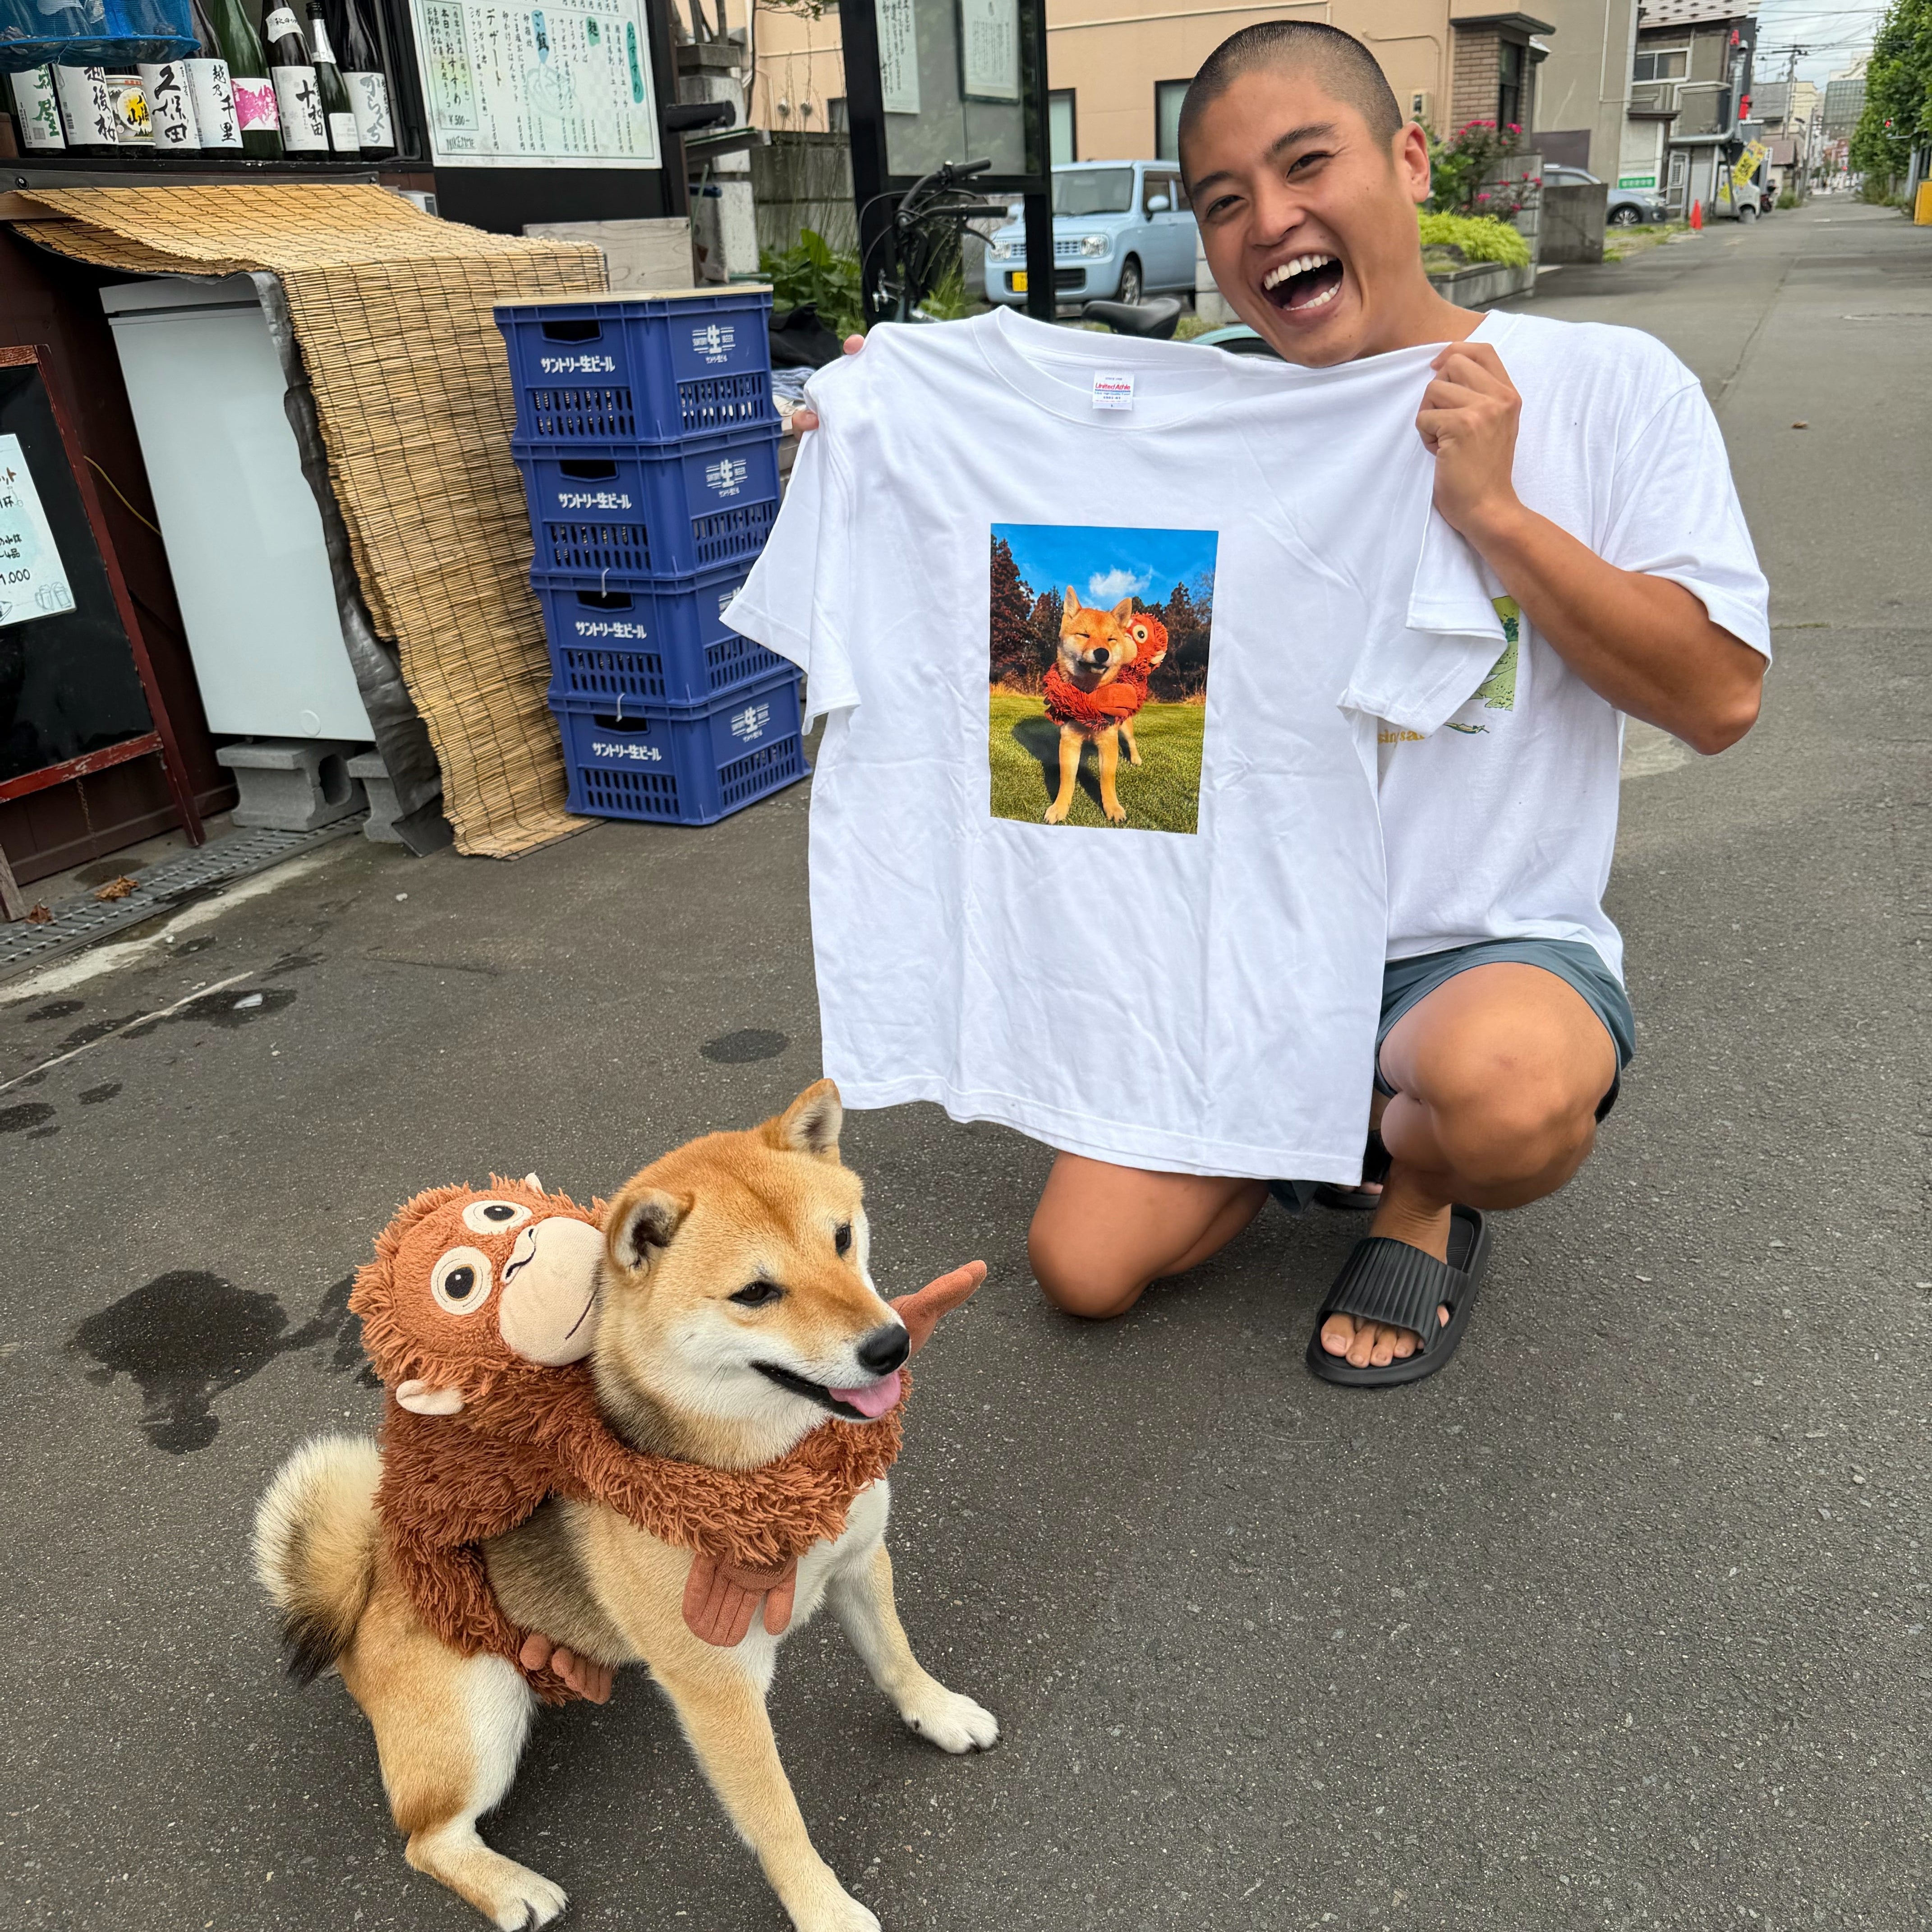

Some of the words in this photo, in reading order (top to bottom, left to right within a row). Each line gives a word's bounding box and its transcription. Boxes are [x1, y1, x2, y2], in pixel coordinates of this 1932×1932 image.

[476, 9, 487, 64] ガリガリ君
[534, 11, 549, 51] ご飯
[588, 21, 599, 37] 麺
[442, 8, 461, 106] 本日のおすすめ
[487, 8, 501, 87] デザート
[627, 27, 641, 95] おすすめ
[152, 65, 187, 143] 久保田
[296, 79, 323, 136] 十和田
[360, 74, 385, 144] からくち
[707, 324, 722, 354] 生
[541, 355, 616, 373] サントリー生ビール
[720, 459, 734, 488] 生
[558, 492, 632, 509] サントリー生ビール
[575, 621, 647, 639] サントリー生ビール
[745, 706, 758, 733] 生
[592, 742, 662, 761] サントリー生ビール
